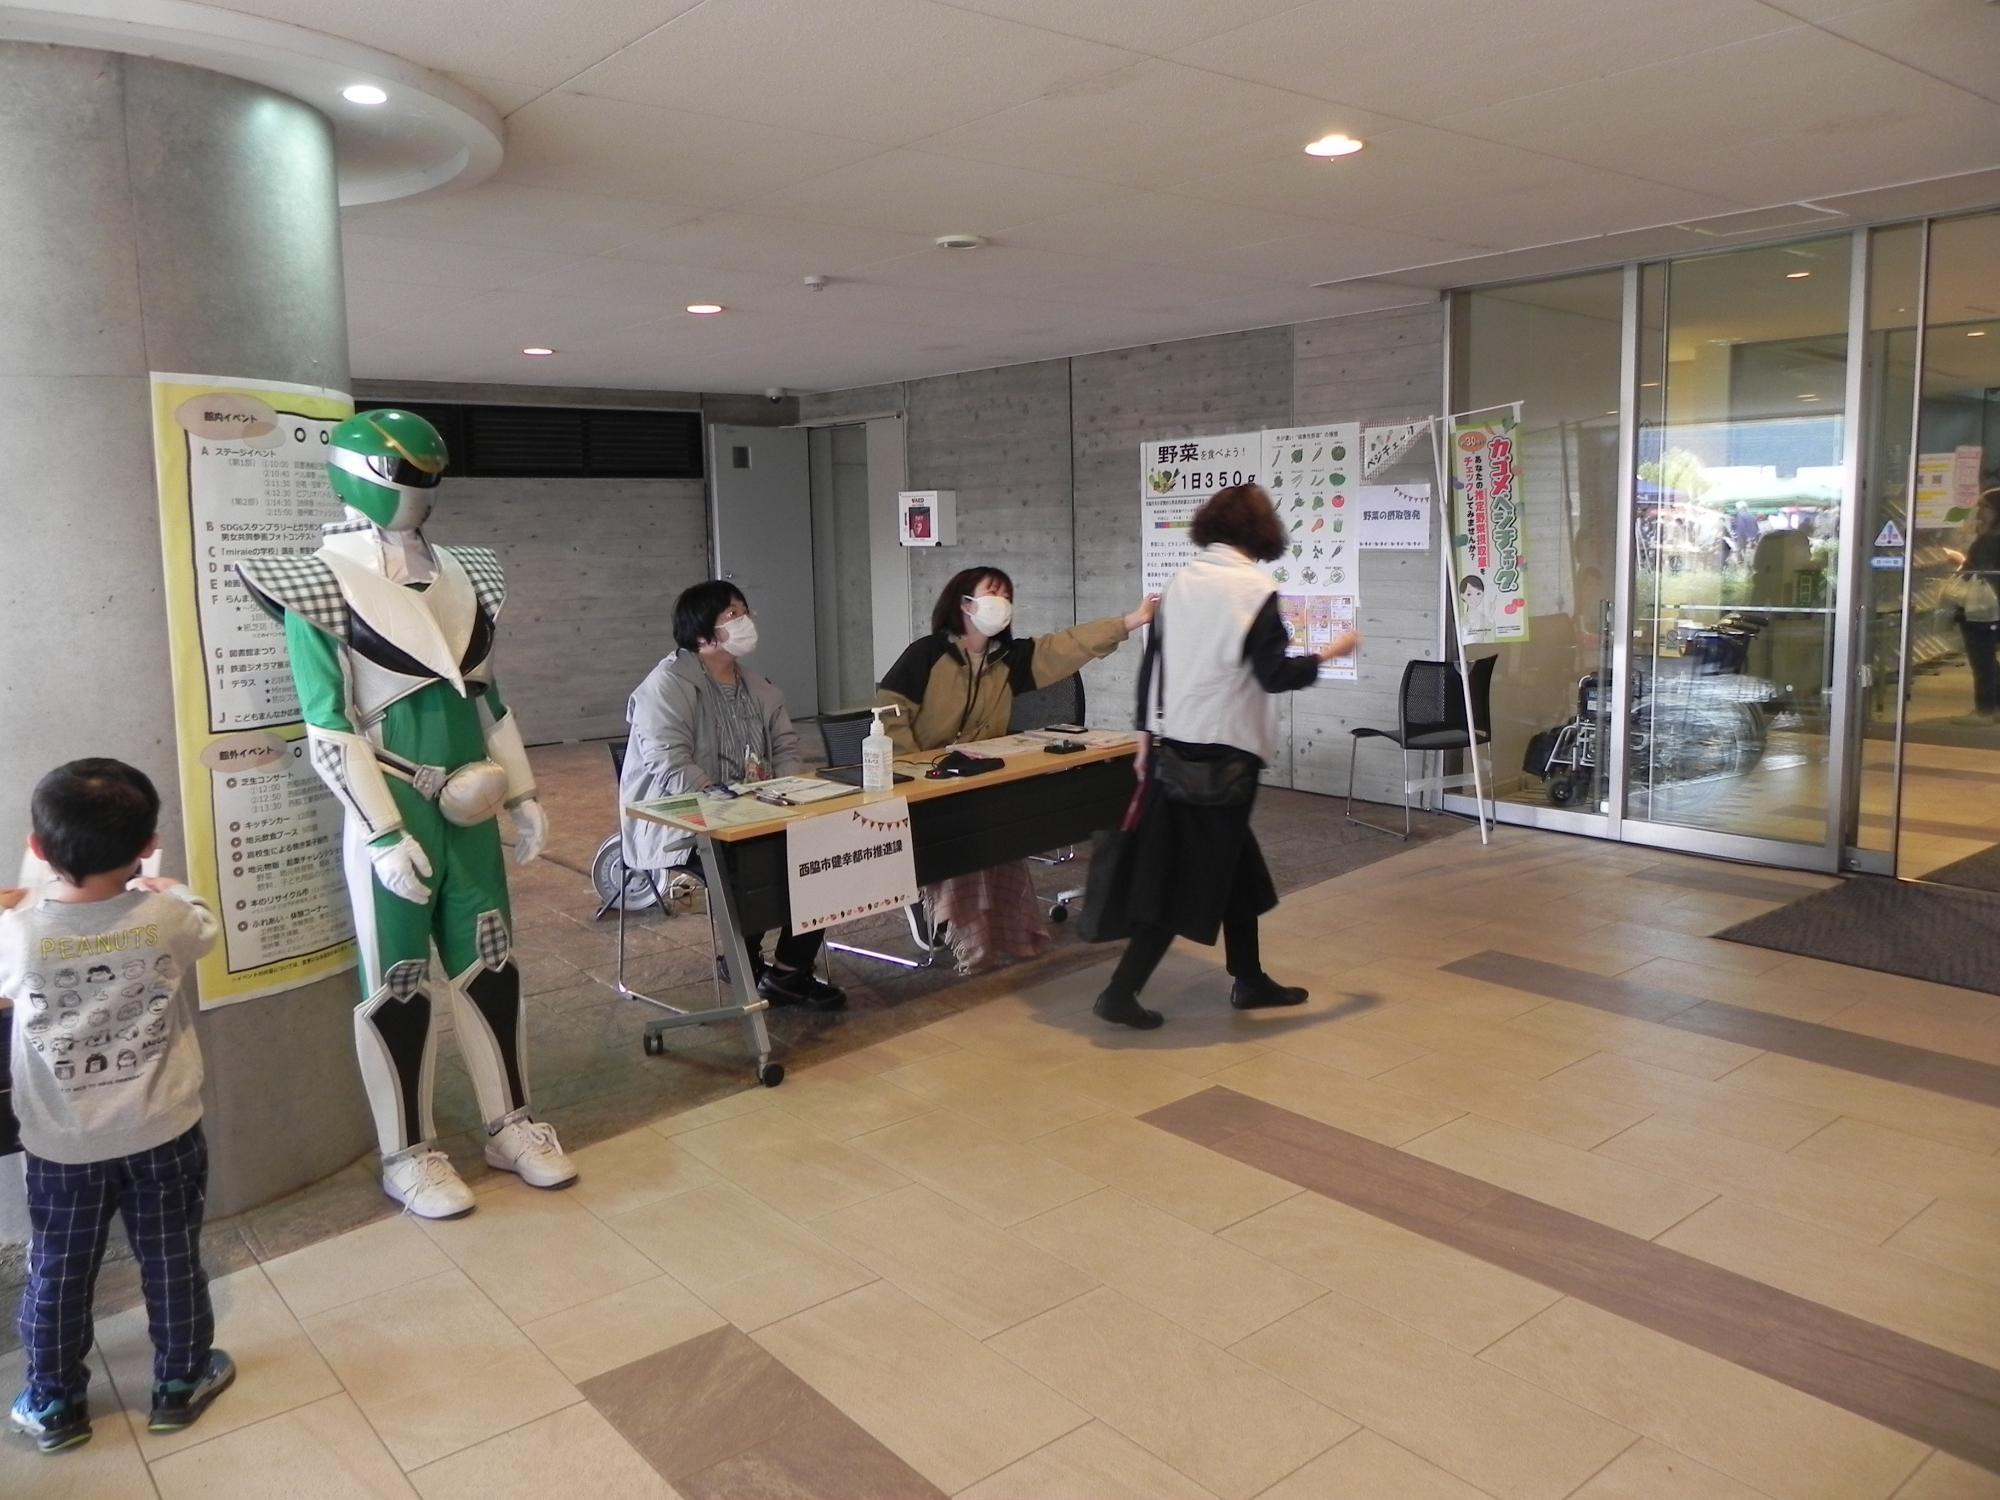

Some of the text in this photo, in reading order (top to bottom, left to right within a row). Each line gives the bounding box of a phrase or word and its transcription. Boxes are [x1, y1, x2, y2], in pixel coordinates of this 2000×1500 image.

[202, 446, 209, 456] A
[206, 522, 214, 532] B
[208, 546, 216, 557] C
[209, 562, 217, 573] D
[210, 579, 218, 590] E
[211, 595, 218, 605] F
[215, 647, 223, 658] G
[216, 664, 224, 675] H
[231, 679, 256, 688] テラス
[798, 840, 903, 878] 西脇市健幸都市推進課
[41, 924, 158, 960] PEANUTS
